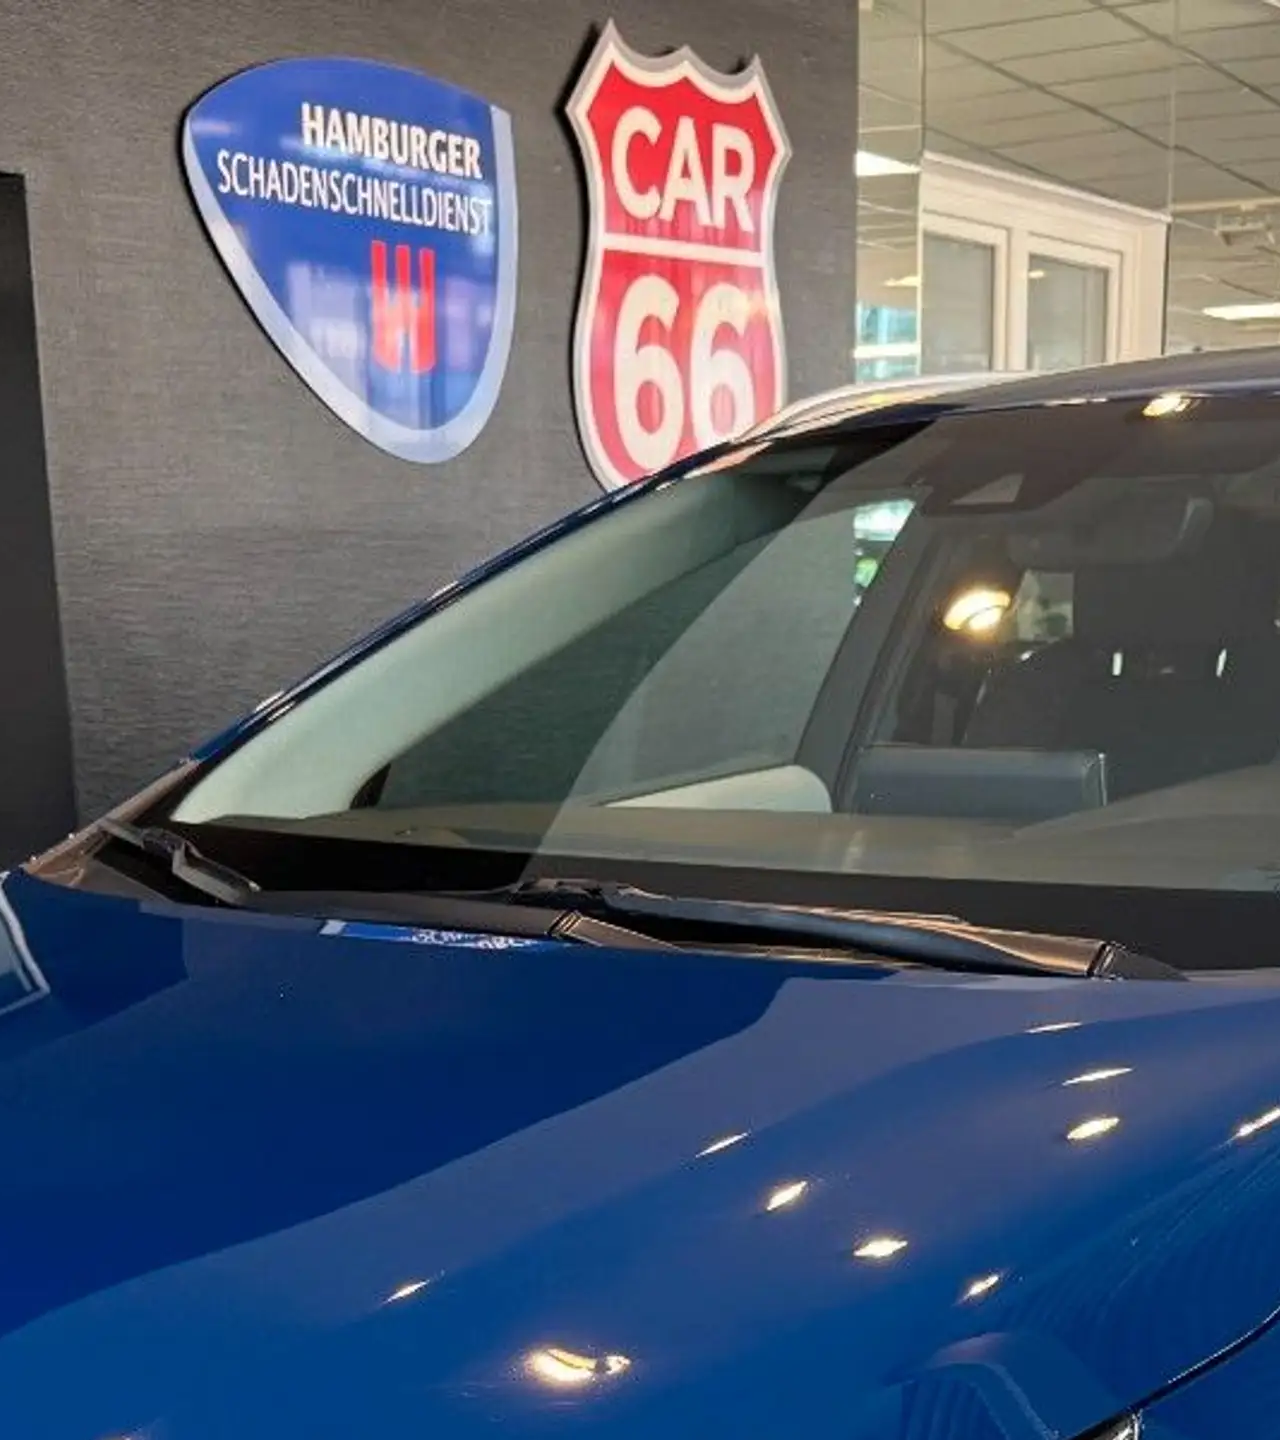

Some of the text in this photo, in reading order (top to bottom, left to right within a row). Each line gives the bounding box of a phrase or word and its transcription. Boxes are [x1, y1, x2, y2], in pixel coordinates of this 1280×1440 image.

[217, 149, 493, 236] SCHADENSCHNELLDIENST
[301, 101, 483, 180] HAMBURGER
[611, 103, 756, 233] CAR
[613, 273, 756, 470] 66
